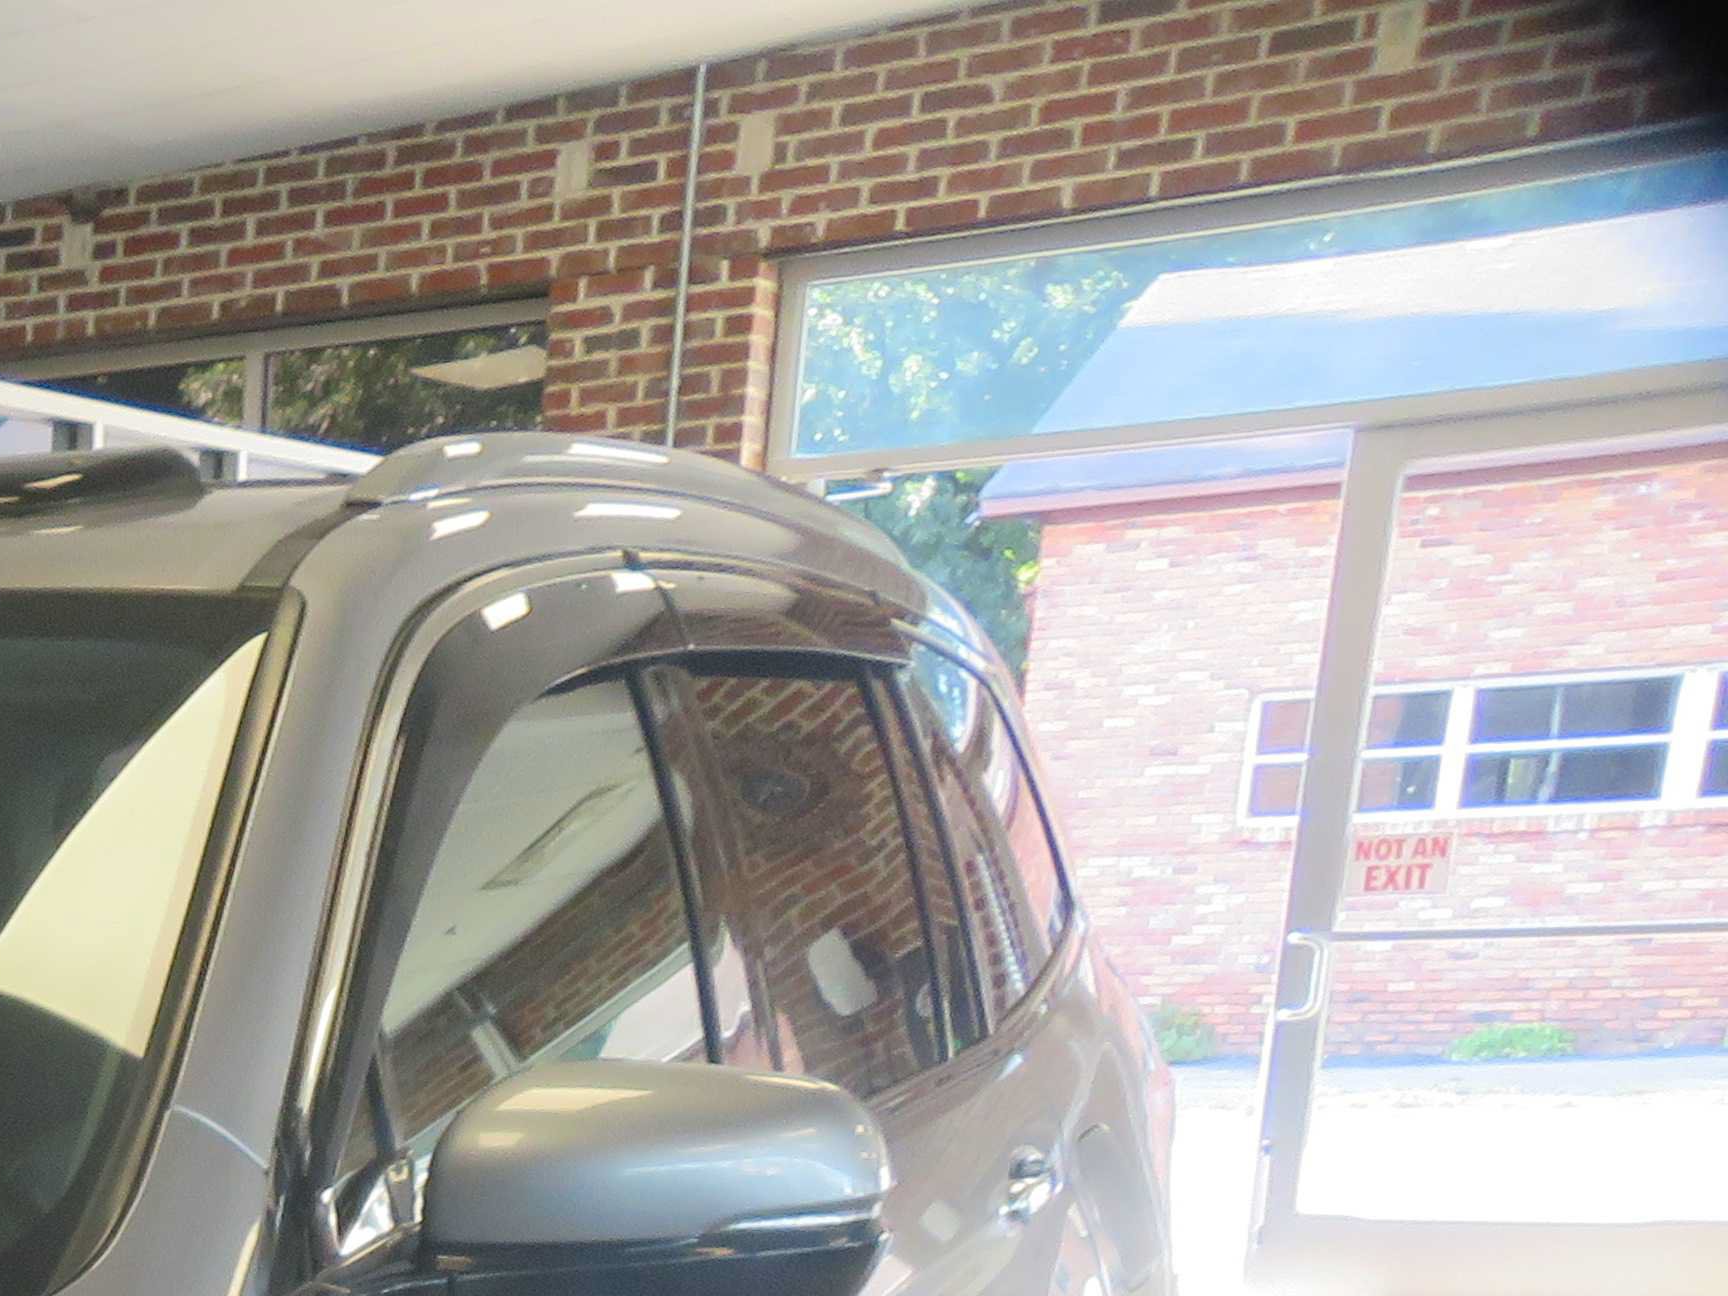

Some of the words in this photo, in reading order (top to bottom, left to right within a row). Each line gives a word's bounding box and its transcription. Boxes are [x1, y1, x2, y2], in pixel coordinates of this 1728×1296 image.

[1355, 837, 1406, 861] NOT
[1412, 835, 1450, 859] AN
[1364, 863, 1433, 892] EXIT
